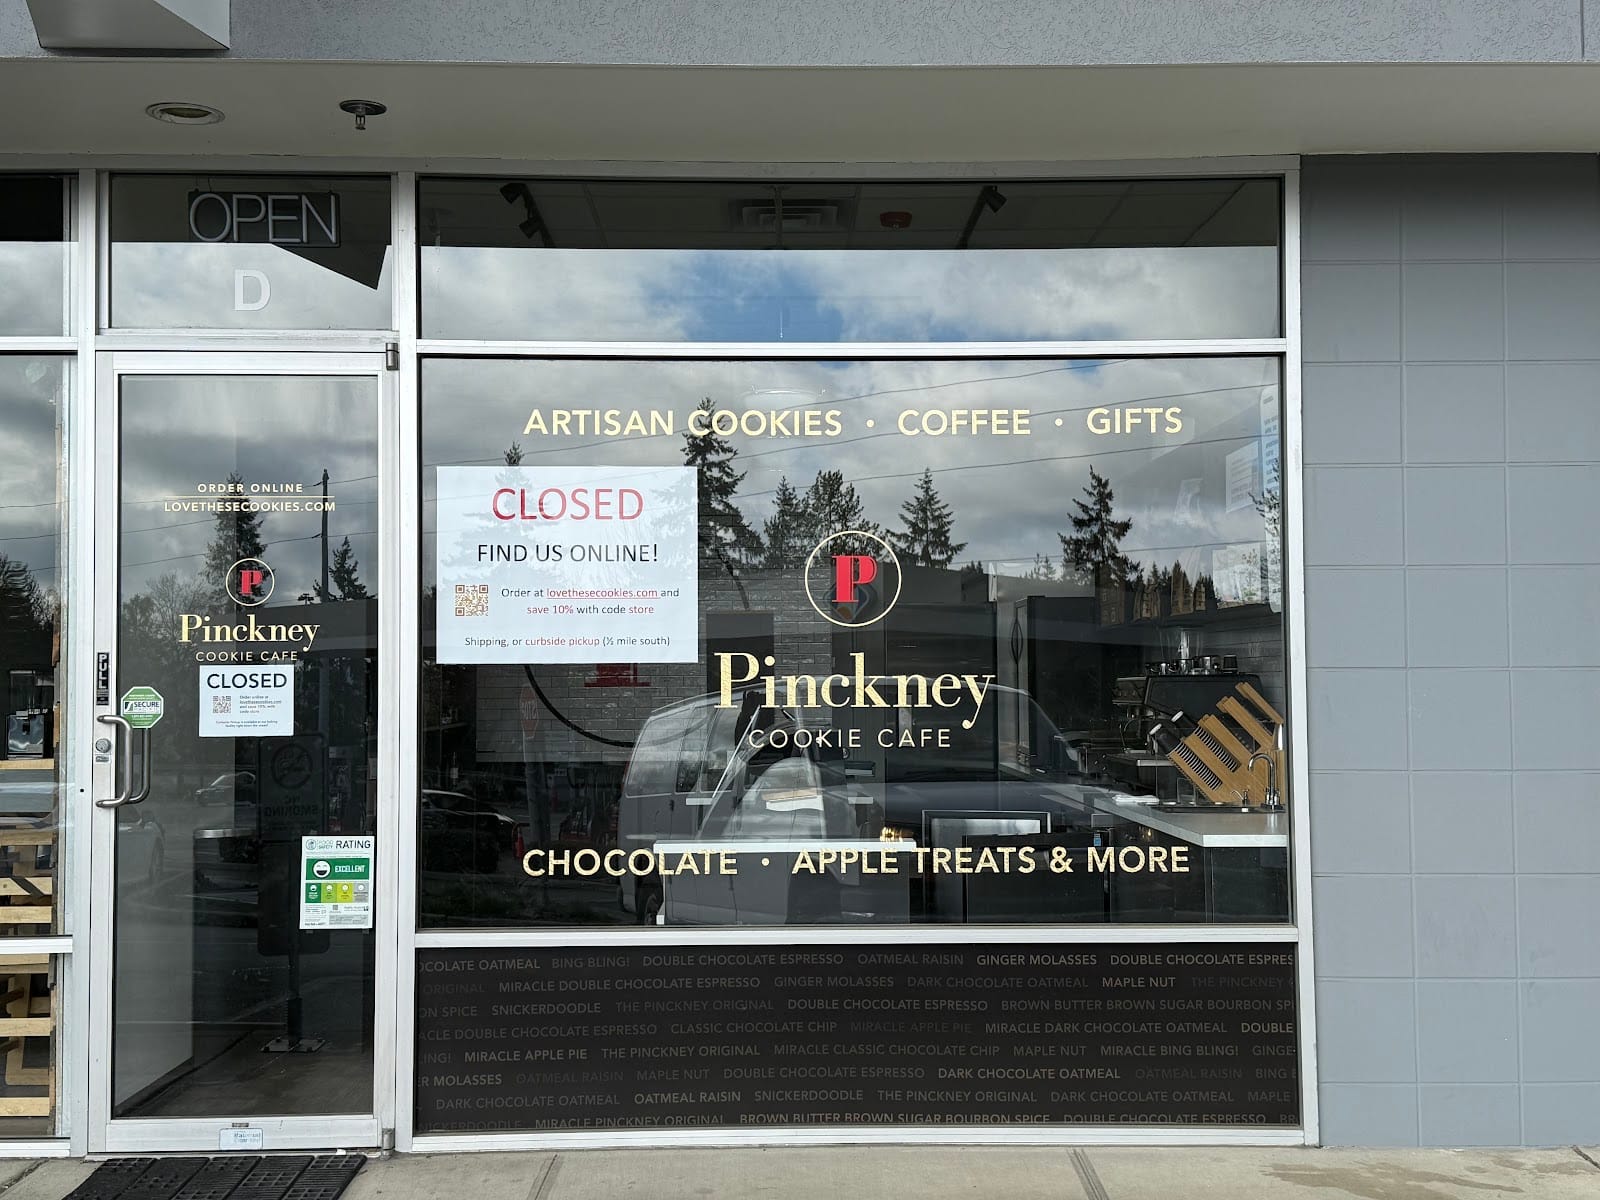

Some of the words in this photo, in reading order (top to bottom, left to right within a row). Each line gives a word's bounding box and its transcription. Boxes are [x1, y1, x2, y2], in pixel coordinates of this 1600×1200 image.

[189, 193, 337, 243] OPEN
[234, 269, 271, 311] D
[523, 408, 674, 436] ARTISAN
[687, 409, 842, 436] COOKIES
[898, 409, 1031, 436] COFFEE
[1087, 406, 1183, 434] GIFTS
[197, 483, 244, 493] ORDER
[250, 483, 303, 493] ONLINE
[164, 501, 336, 512] LOVETHESECOOKIES.COM
[492, 487, 644, 521] CLOSED
[478, 544, 528, 562] FIND
[535, 544, 563, 562] US
[570, 543, 658, 562] ONLINE!
[239, 570, 263, 595] P
[832, 553, 878, 602] P
[501, 588, 531, 598] Order
[534, 589, 544, 598] at
[546, 588, 658, 598] lovethesecookies.com
[660, 588, 680, 597] and
[527, 606, 549, 614] save
[553, 605, 574, 614] 10%
[576, 605, 599, 614] with
[602, 604, 626, 614] code
[628, 605, 654, 614] store
[178, 614, 320, 652] Pinckney
[465, 637, 510, 648] Shipping,
[525, 636, 566, 646] curbside
[569, 636, 600, 647] pickup
[616, 636, 637, 646] mile
[640, 636, 671, 647] south)
[195, 651, 253, 662] COOKIE
[260, 651, 298, 661] CAFE
[99, 654, 108, 689] PULL
[207, 673, 287, 688] CLOSED
[714, 652, 996, 730] Pinckney
[749, 729, 861, 748] COOKIE
[878, 728, 951, 748] CAFE
[336, 840, 371, 849] RATING
[335, 864, 366, 873] EXCELLENT
[522, 848, 738, 877] CHOCOLATE
[792, 847, 897, 874] APPLE
[914, 846, 1036, 874] TREATS
[1049, 846, 1074, 874] &
[1087, 846, 1190, 873] MORE
[479, 958, 541, 971] OATMEAL
[552, 957, 584, 969] BING
[587, 956, 630, 968] BLING!
[643, 955, 695, 967] DOUBLE
[699, 954, 776, 966] CHOCOLATE
[780, 953, 844, 965] ESPRESSO
[857, 953, 919, 965] OATMEAL
[922, 953, 964, 965] RAISIN
[976, 954, 1026, 966] GINGER
[1030, 954, 1097, 966] MOLASSES
[1110, 954, 1163, 966] DOUBLE
[1166, 954, 1244, 965] CHOCOLATE
[500, 980, 555, 992] MIRACLE
[559, 979, 611, 991] DOUBLE
[615, 977, 693, 990] CHOCOLATE
[696, 976, 761, 988] ESPRESSO
[774, 976, 823, 988] GINGER
[827, 976, 894, 988] MOLASSES
[907, 976, 943, 988] DARK
[946, 976, 1023, 988] CHOCOLATE
[1027, 977, 1088, 988] OATMEAL
[1102, 977, 1145, 988] MAPLE
[1149, 977, 1176, 987] NUT
[442, 1005, 478, 1018] SPICE
[491, 1002, 601, 1016] SNICKERDOODLE
[615, 1001, 640, 1013] THE
[644, 1000, 708, 1012] PINCKNEY
[712, 999, 774, 1011] ORIGINAL
[787, 999, 839, 1010] DOUBLE
[843, 999, 920, 1010] CHOCOLATE
[924, 999, 988, 1011] ESPRESSO
[1001, 1000, 1049, 1011] BROWN
[1053, 999, 1103, 1011] BUTTER
[1106, 999, 1155, 1011] BROWN
[1159, 999, 1203, 1011] SUGAR
[1207, 999, 1272, 1011] BOURBON
[454, 1027, 507, 1040] DOUBLE
[511, 1025, 589, 1038] CHOCOLATE
[593, 1024, 657, 1036] ESPRESSO
[671, 1022, 723, 1034] CLASSIC
[726, 1022, 804, 1033] CHOCOLATE
[808, 1021, 838, 1033] CHIP
[985, 1022, 1040, 1034] MIRACLE
[1044, 1022, 1080, 1034] DARK
[1084, 1022, 1162, 1033] CHOCOLATE
[1166, 1022, 1228, 1033] OATMEAL
[1241, 1022, 1293, 1033] DOUBLE
[464, 1050, 520, 1063] MIRACLE
[524, 1049, 564, 1061] APPLE
[568, 1048, 588, 1060] PIE
[601, 1047, 626, 1059] THE
[630, 1046, 695, 1058] PINCKNEY
[699, 1045, 760, 1057] ORIGINAL
[774, 1044, 829, 1056] MIRACLE
[833, 1044, 884, 1055] CLASSIC
[889, 1044, 966, 1056] CHOCOLATE
[970, 1045, 1000, 1056] CHIP
[1013, 1045, 1056, 1056] MAPLE
[1060, 1045, 1087, 1056] NUT
[1100, 1045, 1156, 1056] MIRACLE
[1160, 1045, 1192, 1056] BING
[1196, 1045, 1239, 1056] BLING!
[433, 1074, 502, 1087] MOLASSES
[636, 1069, 680, 1081] MAPLE
[683, 1068, 710, 1080] NUT
[724, 1067, 775, 1079] DOUBLE
[779, 1067, 857, 1079] CHOCOLATE
[861, 1067, 925, 1079] ESPRESSO
[938, 1068, 973, 1079] DARK
[977, 1068, 1055, 1079] CHOCOLATE
[1059, 1068, 1120, 1079] OATMEAL
[1255, 1068, 1287, 1079] BING
[436, 1098, 472, 1110] DARK
[475, 1096, 554, 1109] CHOCOLATE
[558, 1094, 620, 1107] OATMEAL
[634, 1092, 696, 1105] OATMEAL
[699, 1091, 741, 1103] RAISIN
[754, 1089, 864, 1101] SNICKERDOODLE
[878, 1090, 903, 1101] THE
[906, 1090, 971, 1102] PINCKNEY
[975, 1090, 1037, 1102] ORIGINAL
[1050, 1091, 1086, 1102] DARK
[1090, 1091, 1168, 1102] CHOCOLATE
[1172, 1091, 1234, 1102] OATMEAL
[1248, 1091, 1291, 1102] MAPLE
